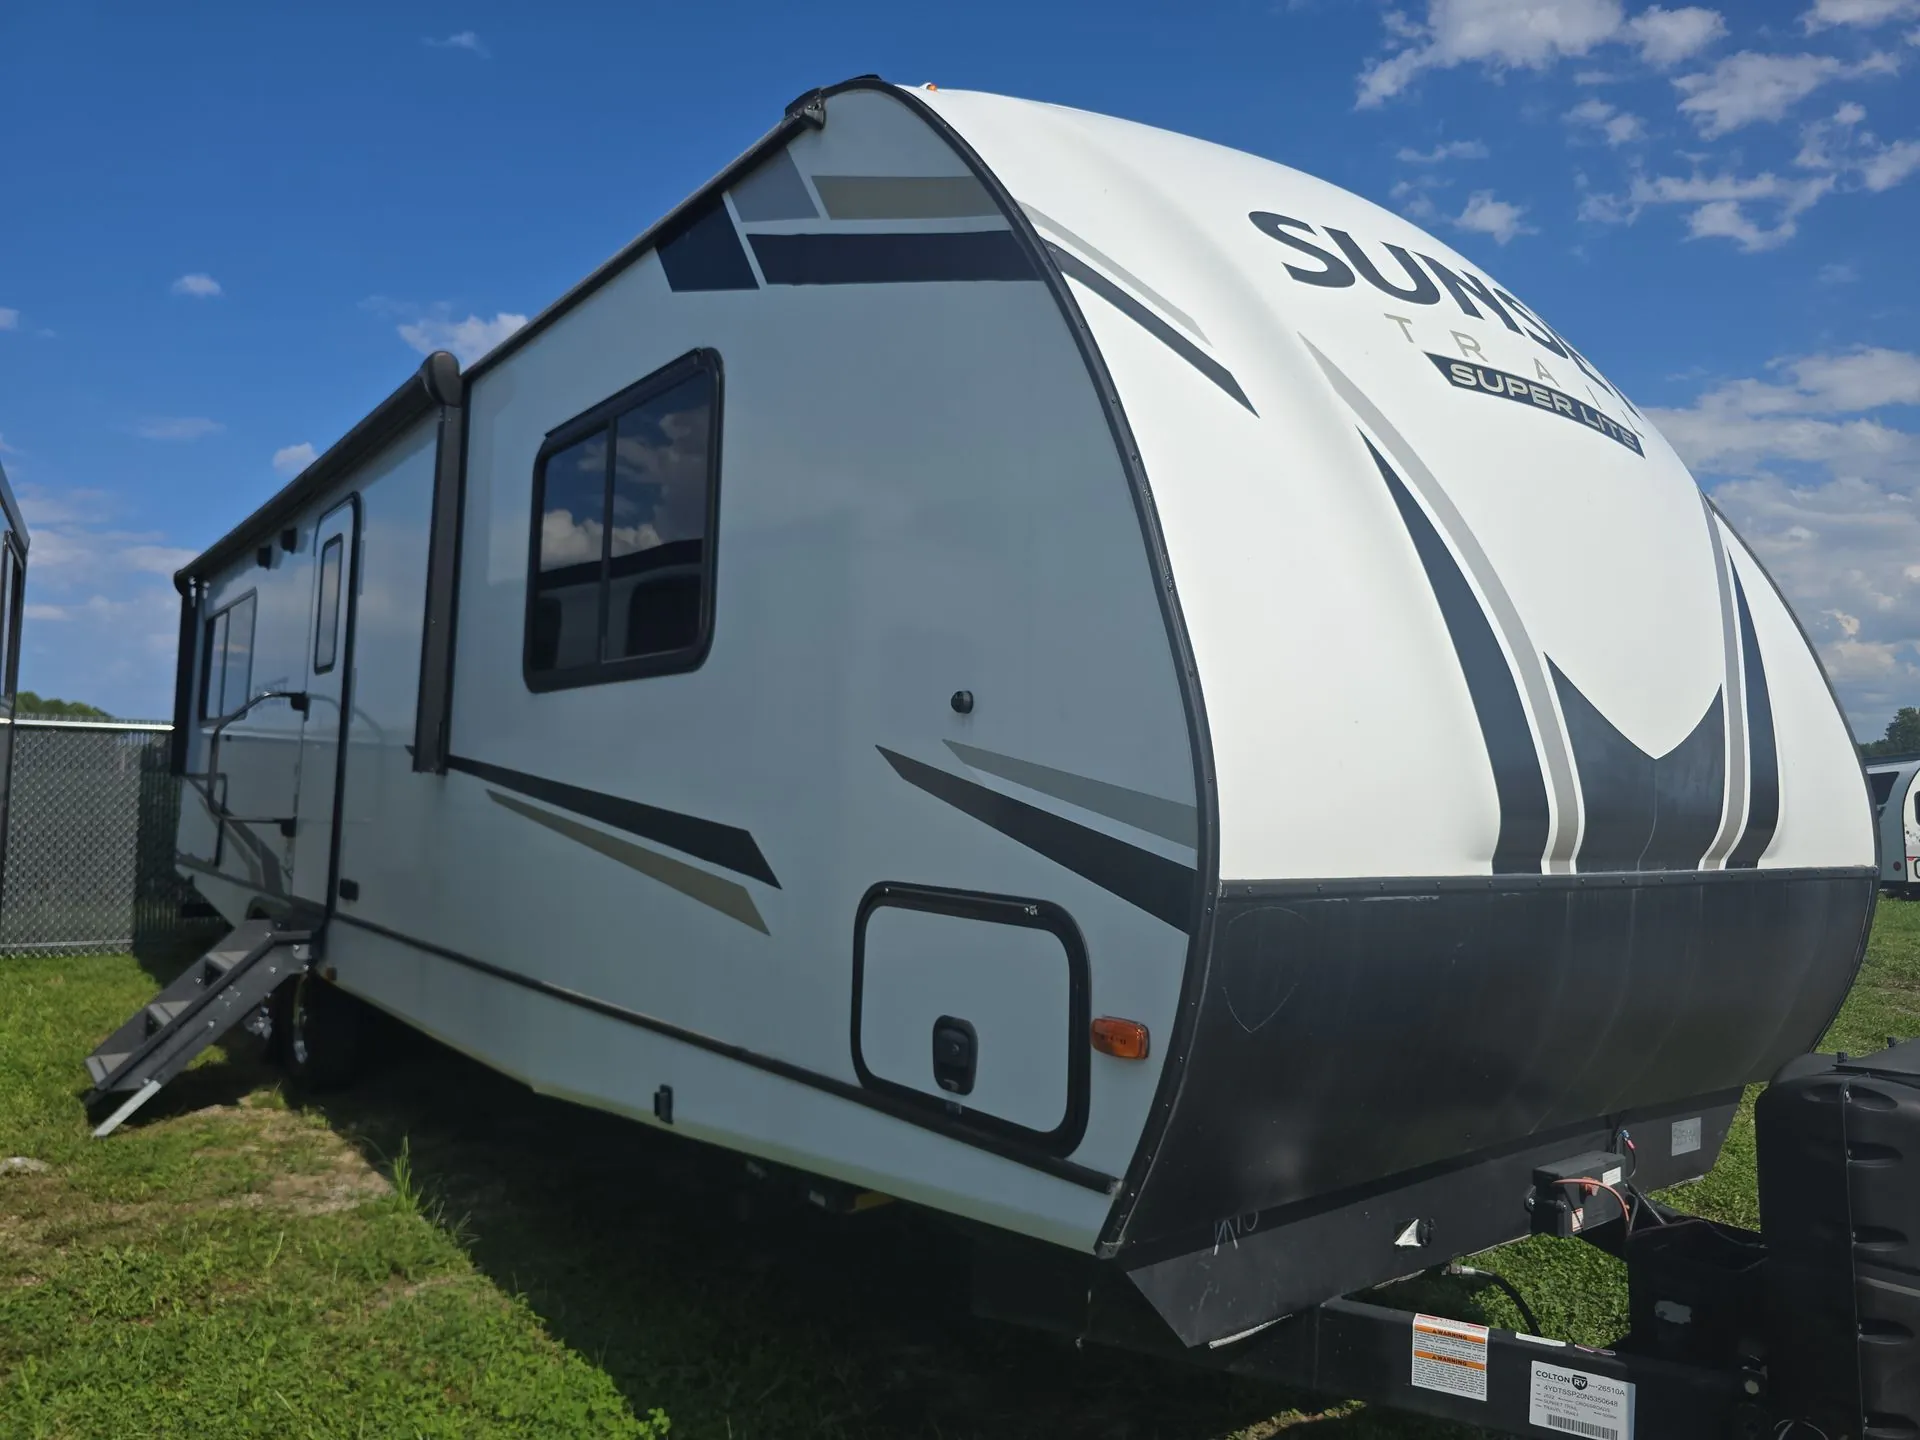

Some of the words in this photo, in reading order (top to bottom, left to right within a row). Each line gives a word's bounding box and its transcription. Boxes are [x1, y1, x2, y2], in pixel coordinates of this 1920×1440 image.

[1384, 313, 1645, 439] TRAIL
[1450, 363, 1576, 418] SUPER
[1579, 405, 1638, 450] LITE
[1437, 1328, 1468, 1341] WARNING
[1437, 1354, 1468, 1367] WARNING
[1535, 1370, 1570, 1383] COLTON
